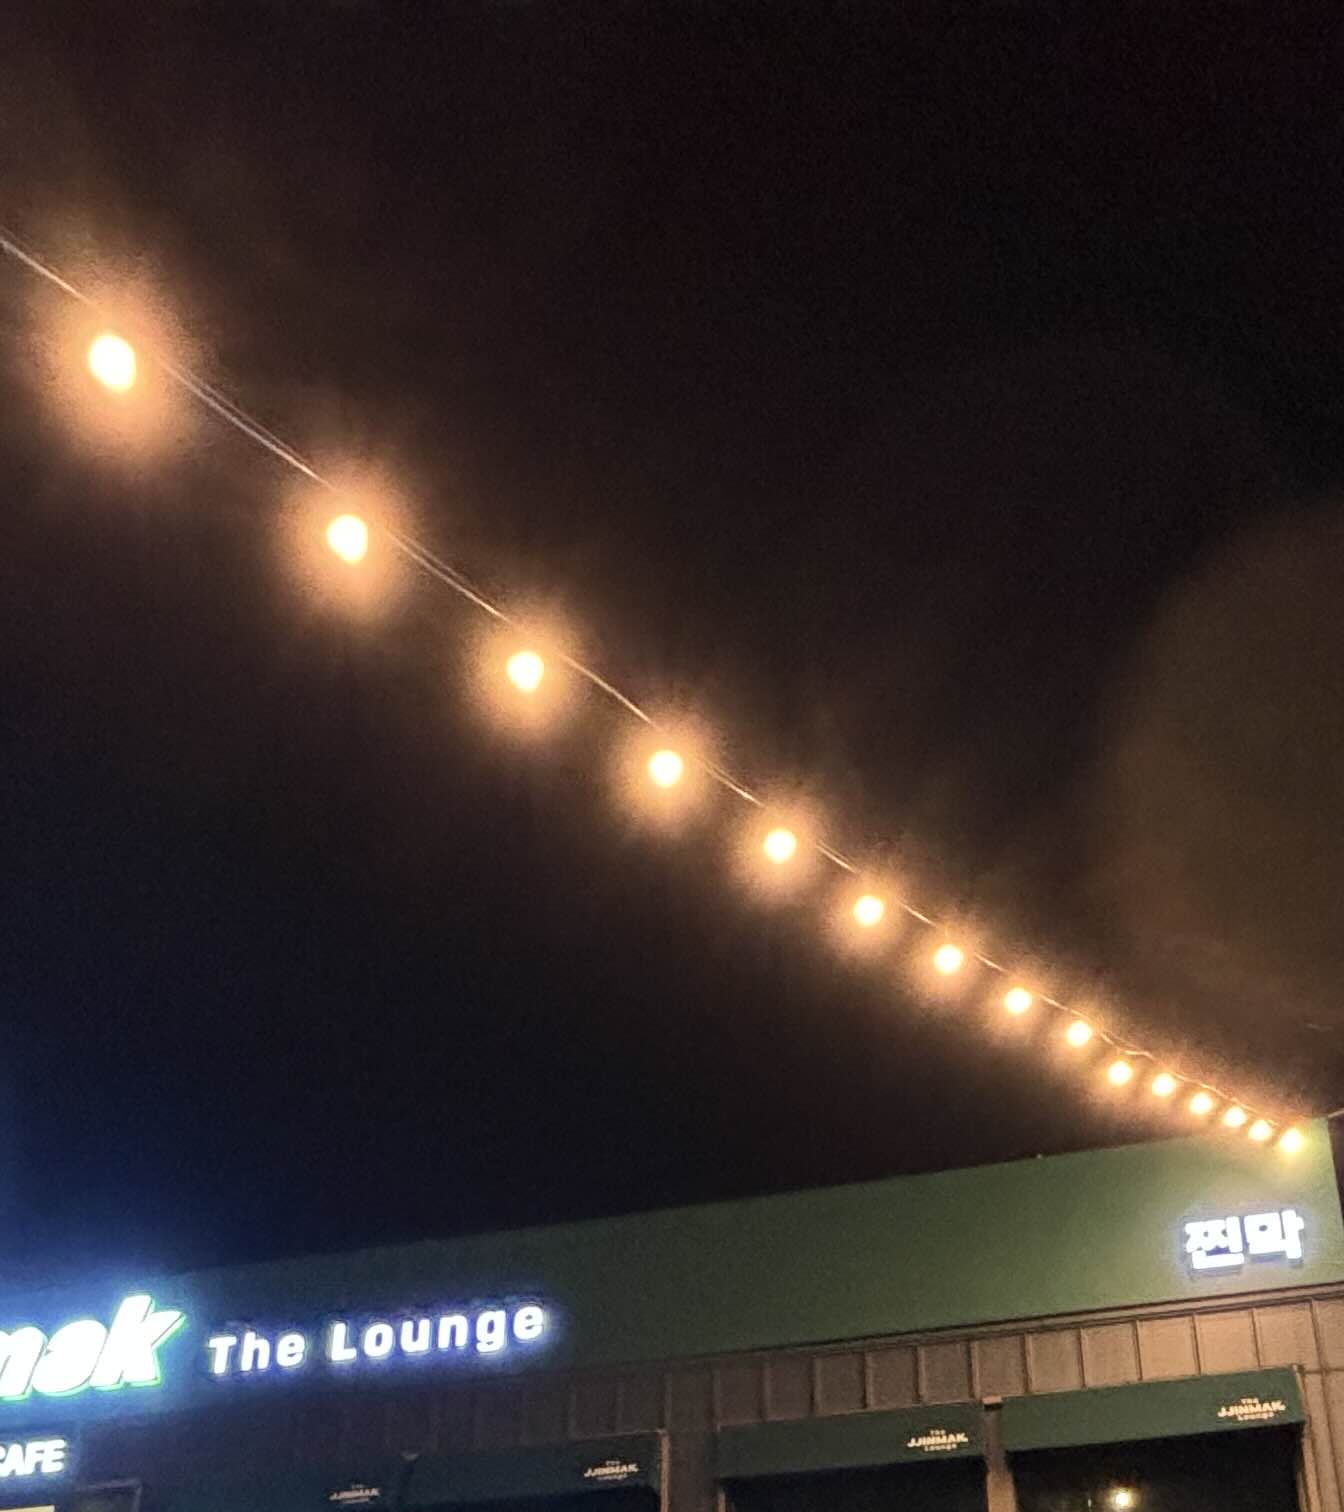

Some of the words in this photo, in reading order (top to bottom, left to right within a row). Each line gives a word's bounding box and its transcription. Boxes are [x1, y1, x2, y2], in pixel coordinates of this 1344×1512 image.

[1184, 1209, 1305, 1270] 찐막
[209, 1331, 306, 1374] The
[330, 1306, 544, 1362] Lounge
[1217, 1401, 1286, 1417] JJINMAK
[907, 1432, 969, 1448] JJINMAK
